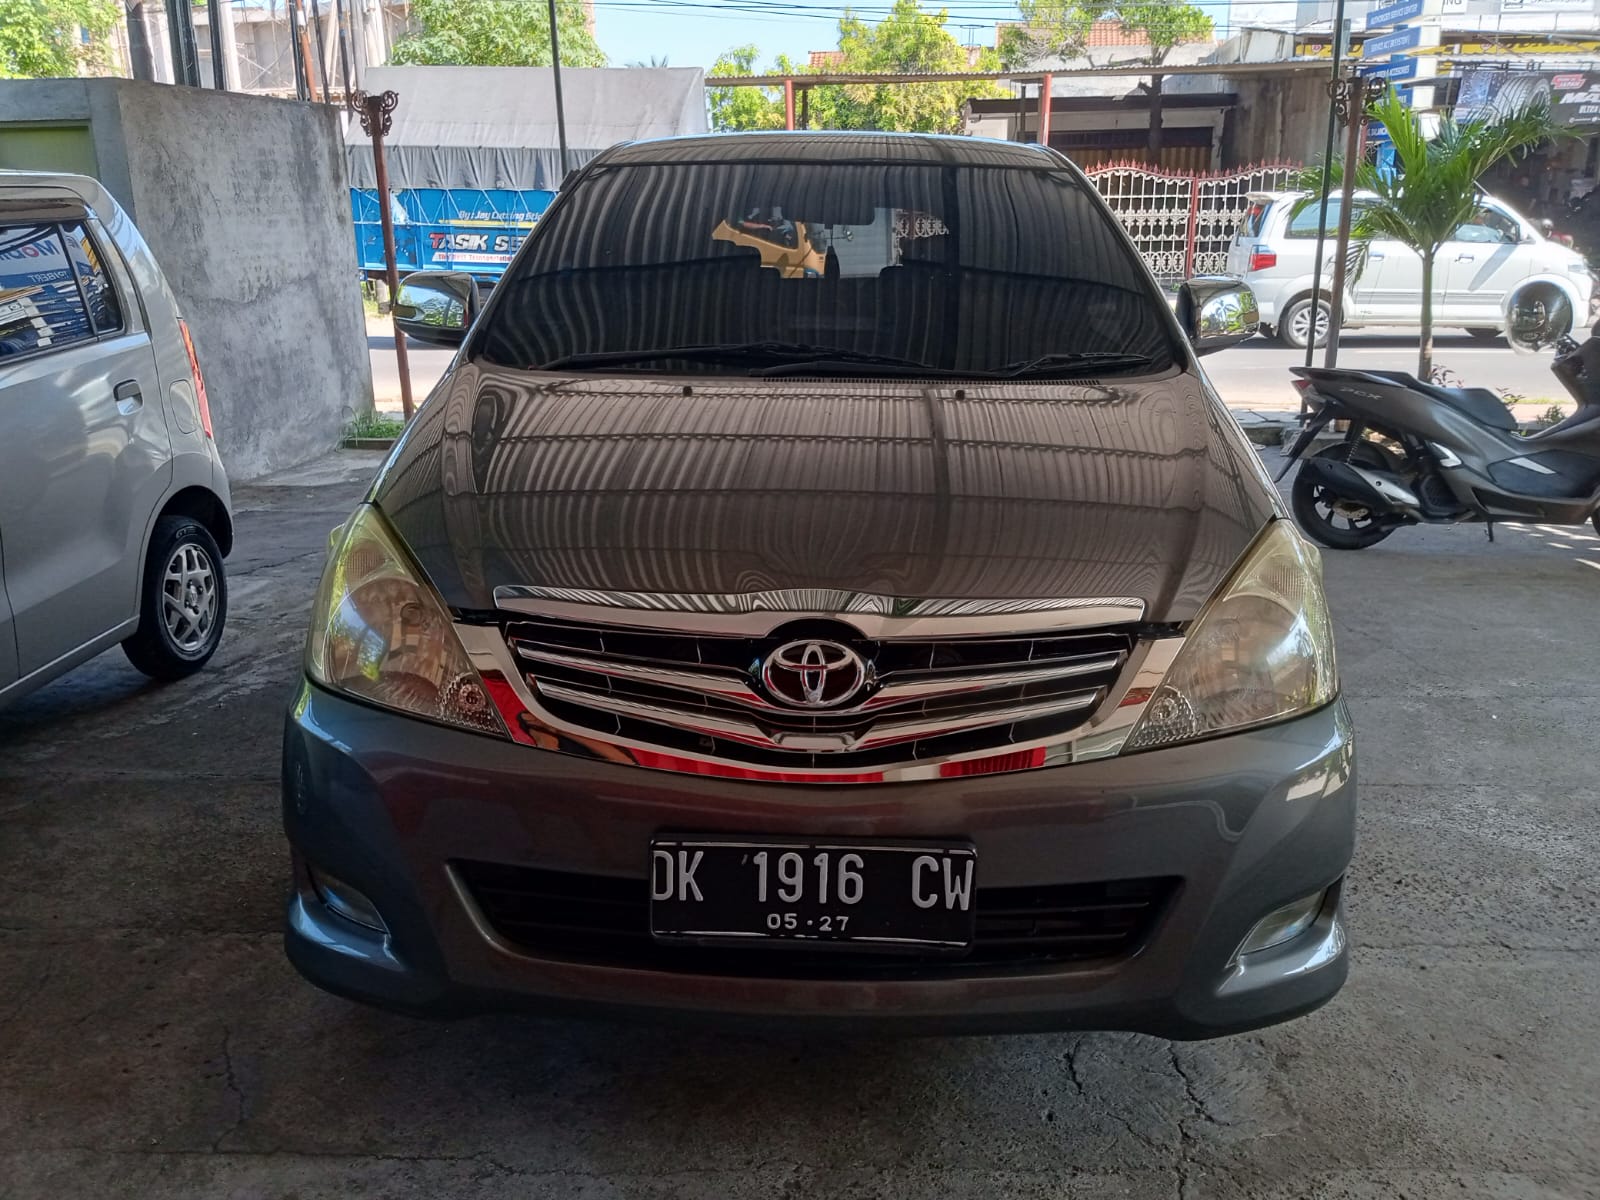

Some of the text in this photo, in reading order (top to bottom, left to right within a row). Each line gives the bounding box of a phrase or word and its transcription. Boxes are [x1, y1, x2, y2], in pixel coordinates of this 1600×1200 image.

[429, 232, 488, 252] TASIK
[652, 850, 974, 911] DK 1916 CW
